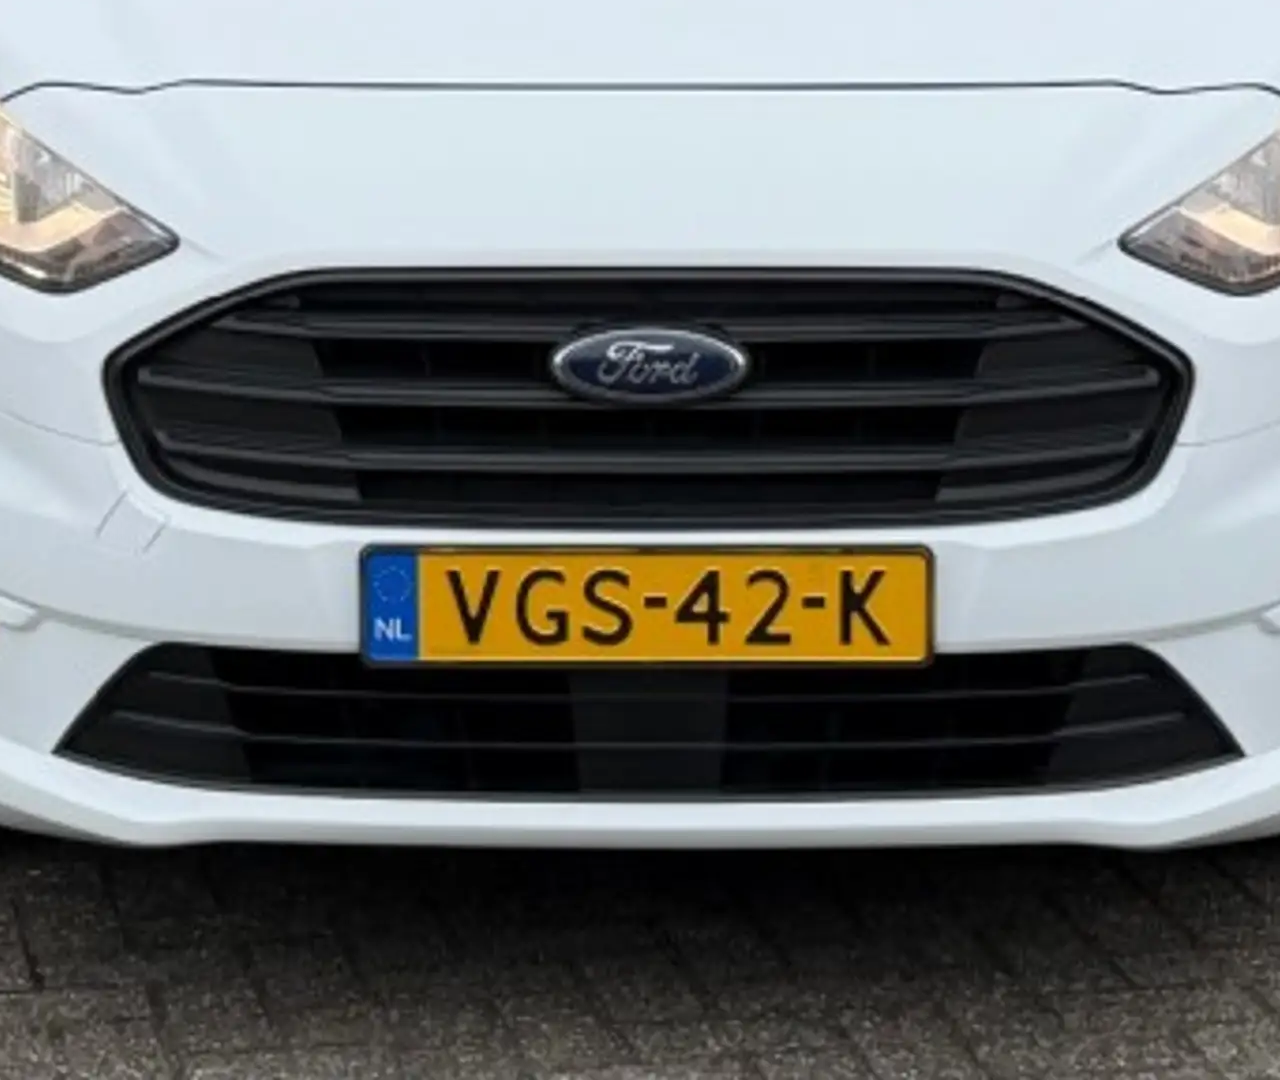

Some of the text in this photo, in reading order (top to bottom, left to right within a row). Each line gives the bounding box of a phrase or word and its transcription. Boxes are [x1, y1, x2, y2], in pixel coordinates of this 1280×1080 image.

[596, 340, 701, 385] Ford
[444, 568, 893, 647] VGS-42-K
[372, 619, 413, 642] NL
